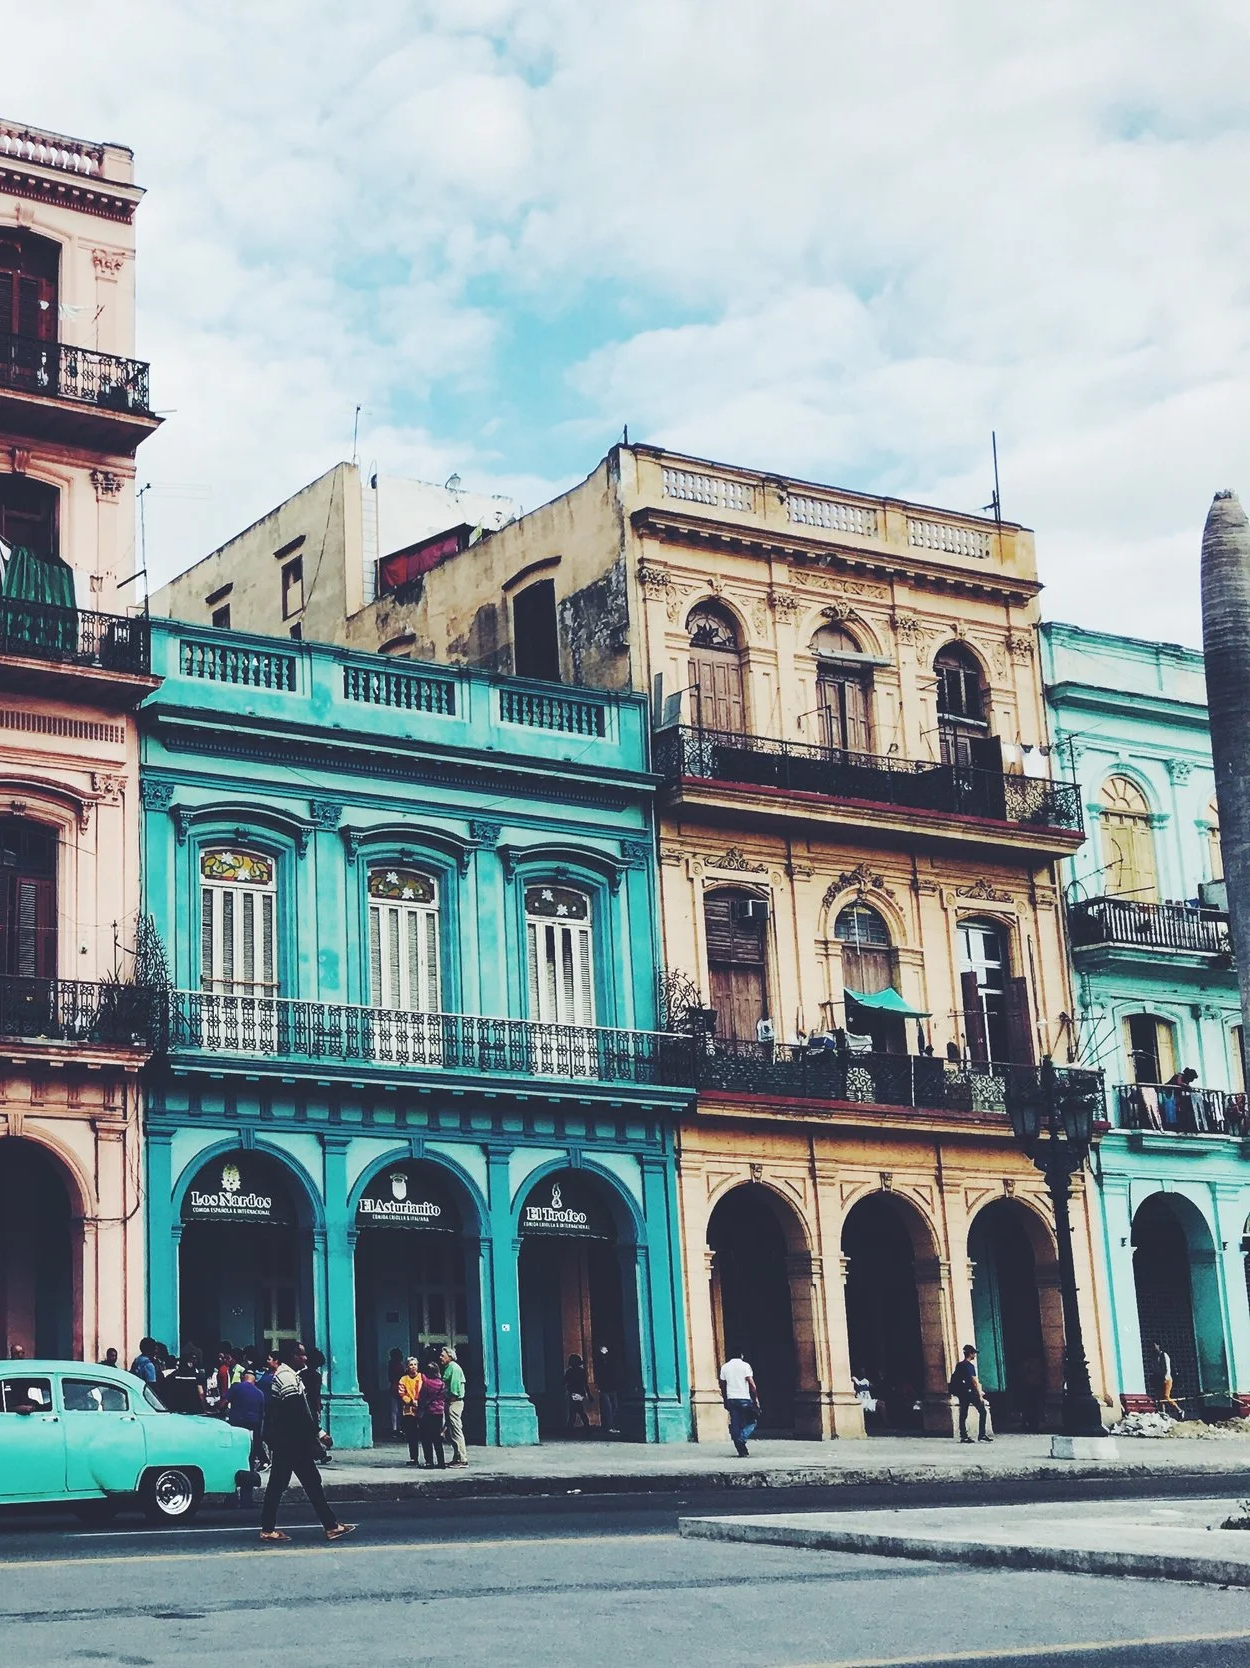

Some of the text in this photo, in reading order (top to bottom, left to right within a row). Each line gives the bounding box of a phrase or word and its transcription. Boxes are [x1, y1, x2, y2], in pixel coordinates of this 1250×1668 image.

[191, 1192, 271, 1208] Los Nardos
[359, 1199, 441, 1217] El Asturianito
[526, 1207, 587, 1223] El Trofeo
